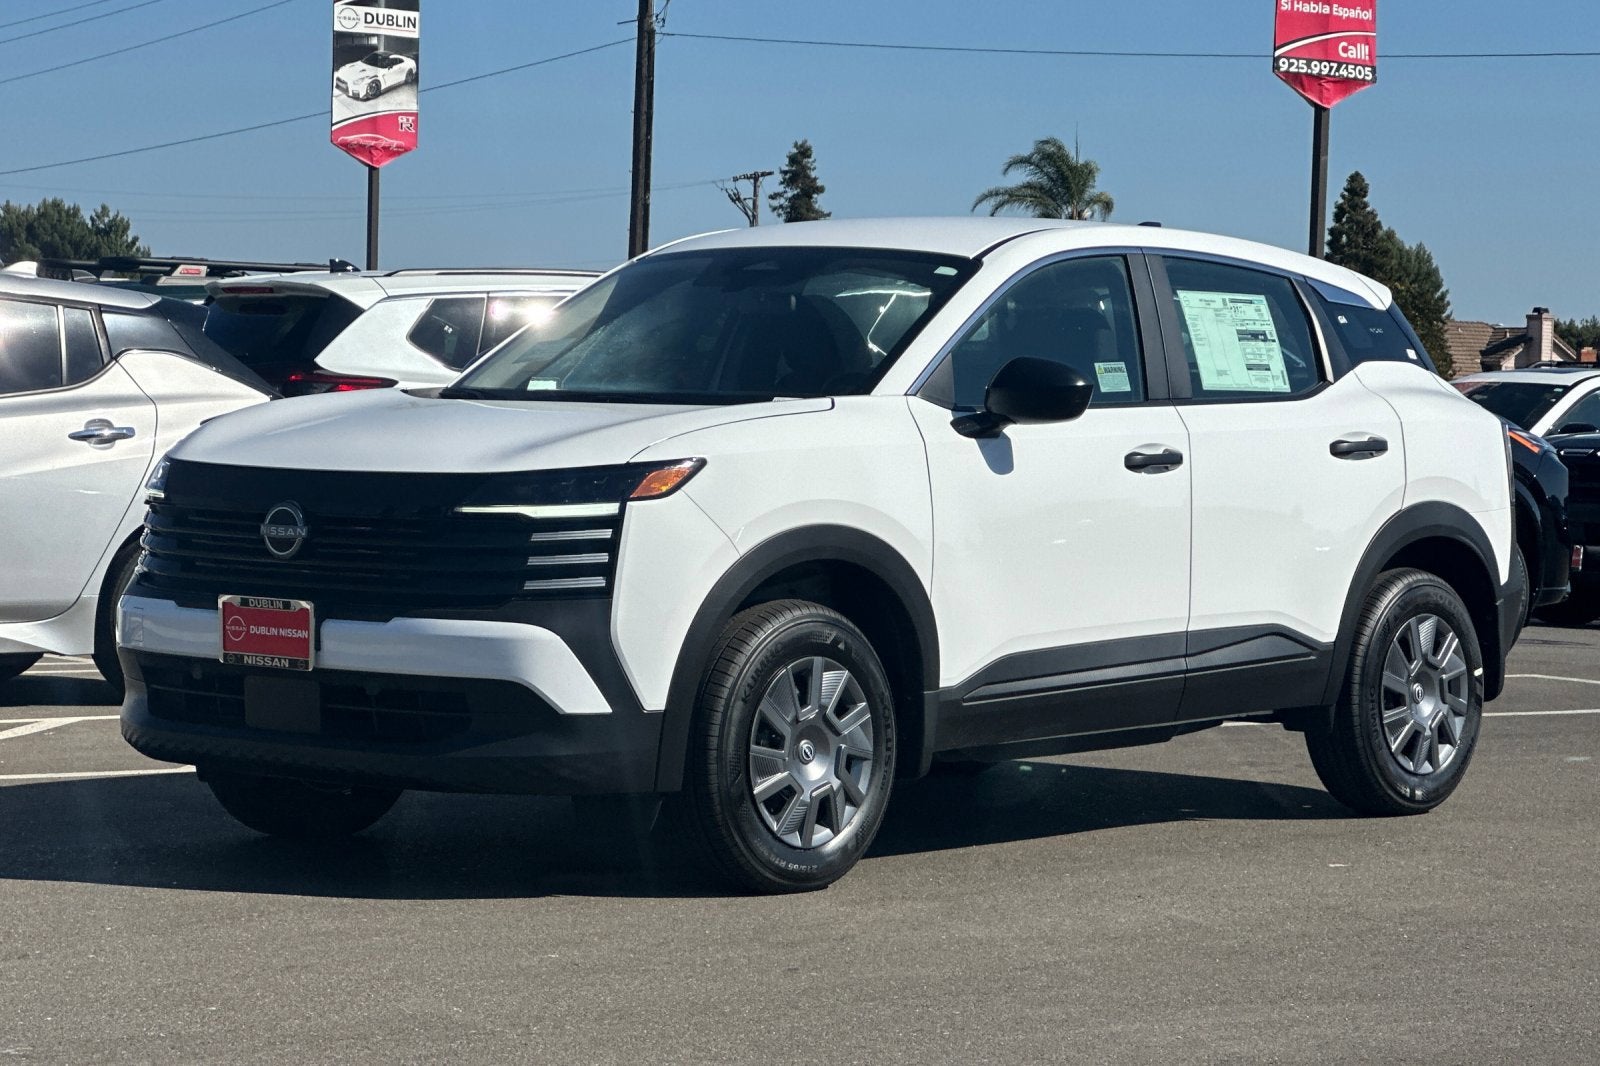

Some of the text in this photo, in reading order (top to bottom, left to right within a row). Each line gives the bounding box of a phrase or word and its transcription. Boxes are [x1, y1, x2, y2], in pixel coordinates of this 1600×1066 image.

[1294, 1, 1330, 14] Habla
[1333, 4, 1372, 20] Español
[364, 12, 417, 29] DUBLIN
[1338, 41, 1370, 60] Call!
[1279, 58, 1373, 80] 925.997.4505
[260, 525, 307, 537] NISSAN
[249, 598, 283, 609] DUBLIN
[250, 625, 309, 639] DUBLIN NISSAN
[243, 655, 290, 668] NISSAN
